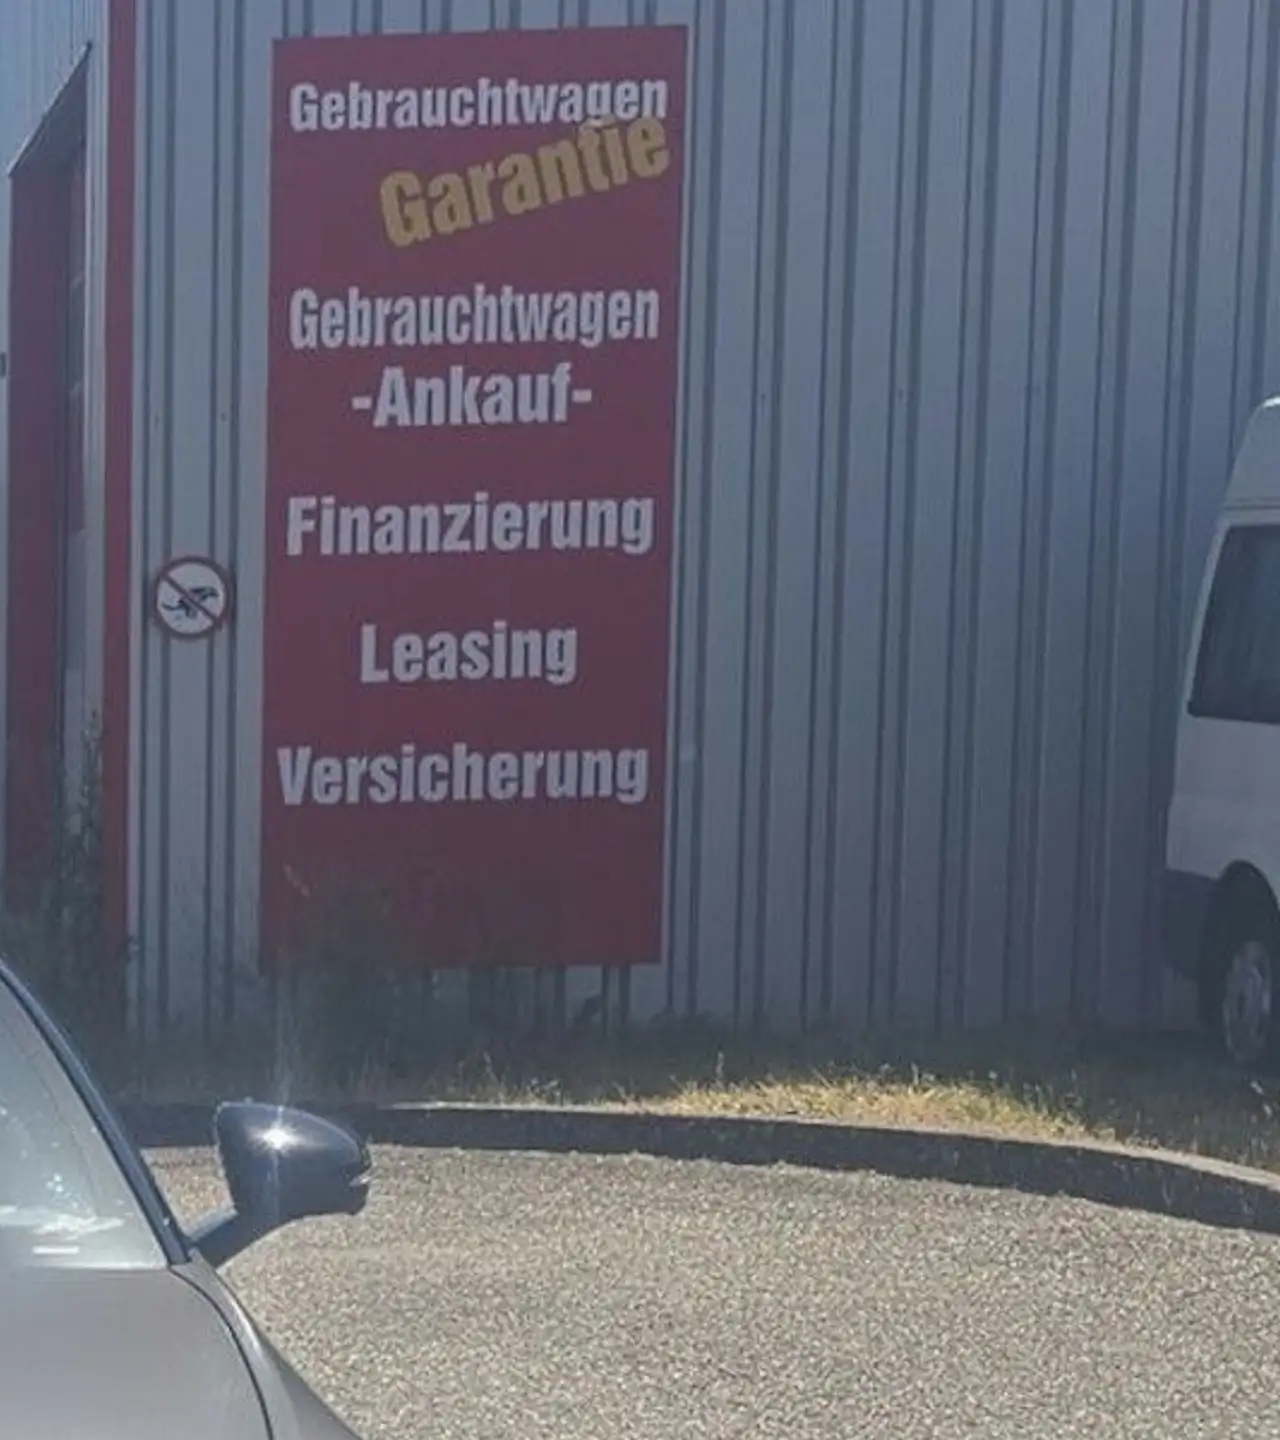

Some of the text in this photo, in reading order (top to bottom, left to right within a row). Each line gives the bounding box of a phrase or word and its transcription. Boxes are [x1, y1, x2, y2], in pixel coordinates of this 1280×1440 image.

[290, 77, 668, 132] Gebrauchtwagen
[380, 119, 671, 246] Garantie
[289, 283, 659, 348] Gebrauchtwagen
[351, 362, 593, 427] -Ankauf-
[286, 491, 654, 556] Finanzierung
[359, 620, 578, 684] Leasing
[277, 742, 649, 806] Versicherung
